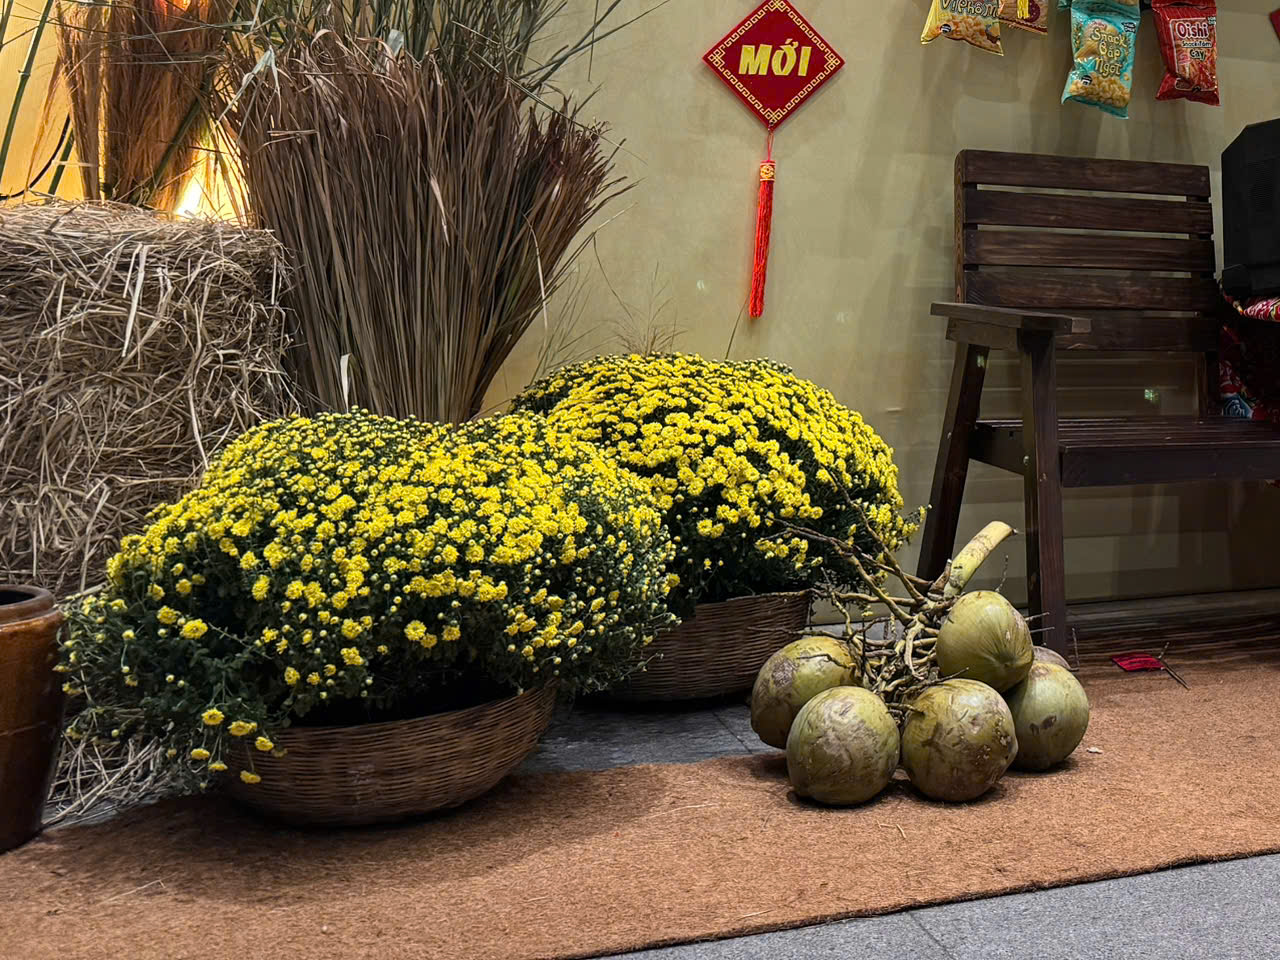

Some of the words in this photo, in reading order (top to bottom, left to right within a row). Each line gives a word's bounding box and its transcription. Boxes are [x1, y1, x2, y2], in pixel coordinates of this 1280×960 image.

[1091, 26, 1127, 48] Snack
[1176, 21, 1210, 38] Oishi
[738, 37, 812, 79] MỚI
[1189, 48, 1207, 62] Cay
